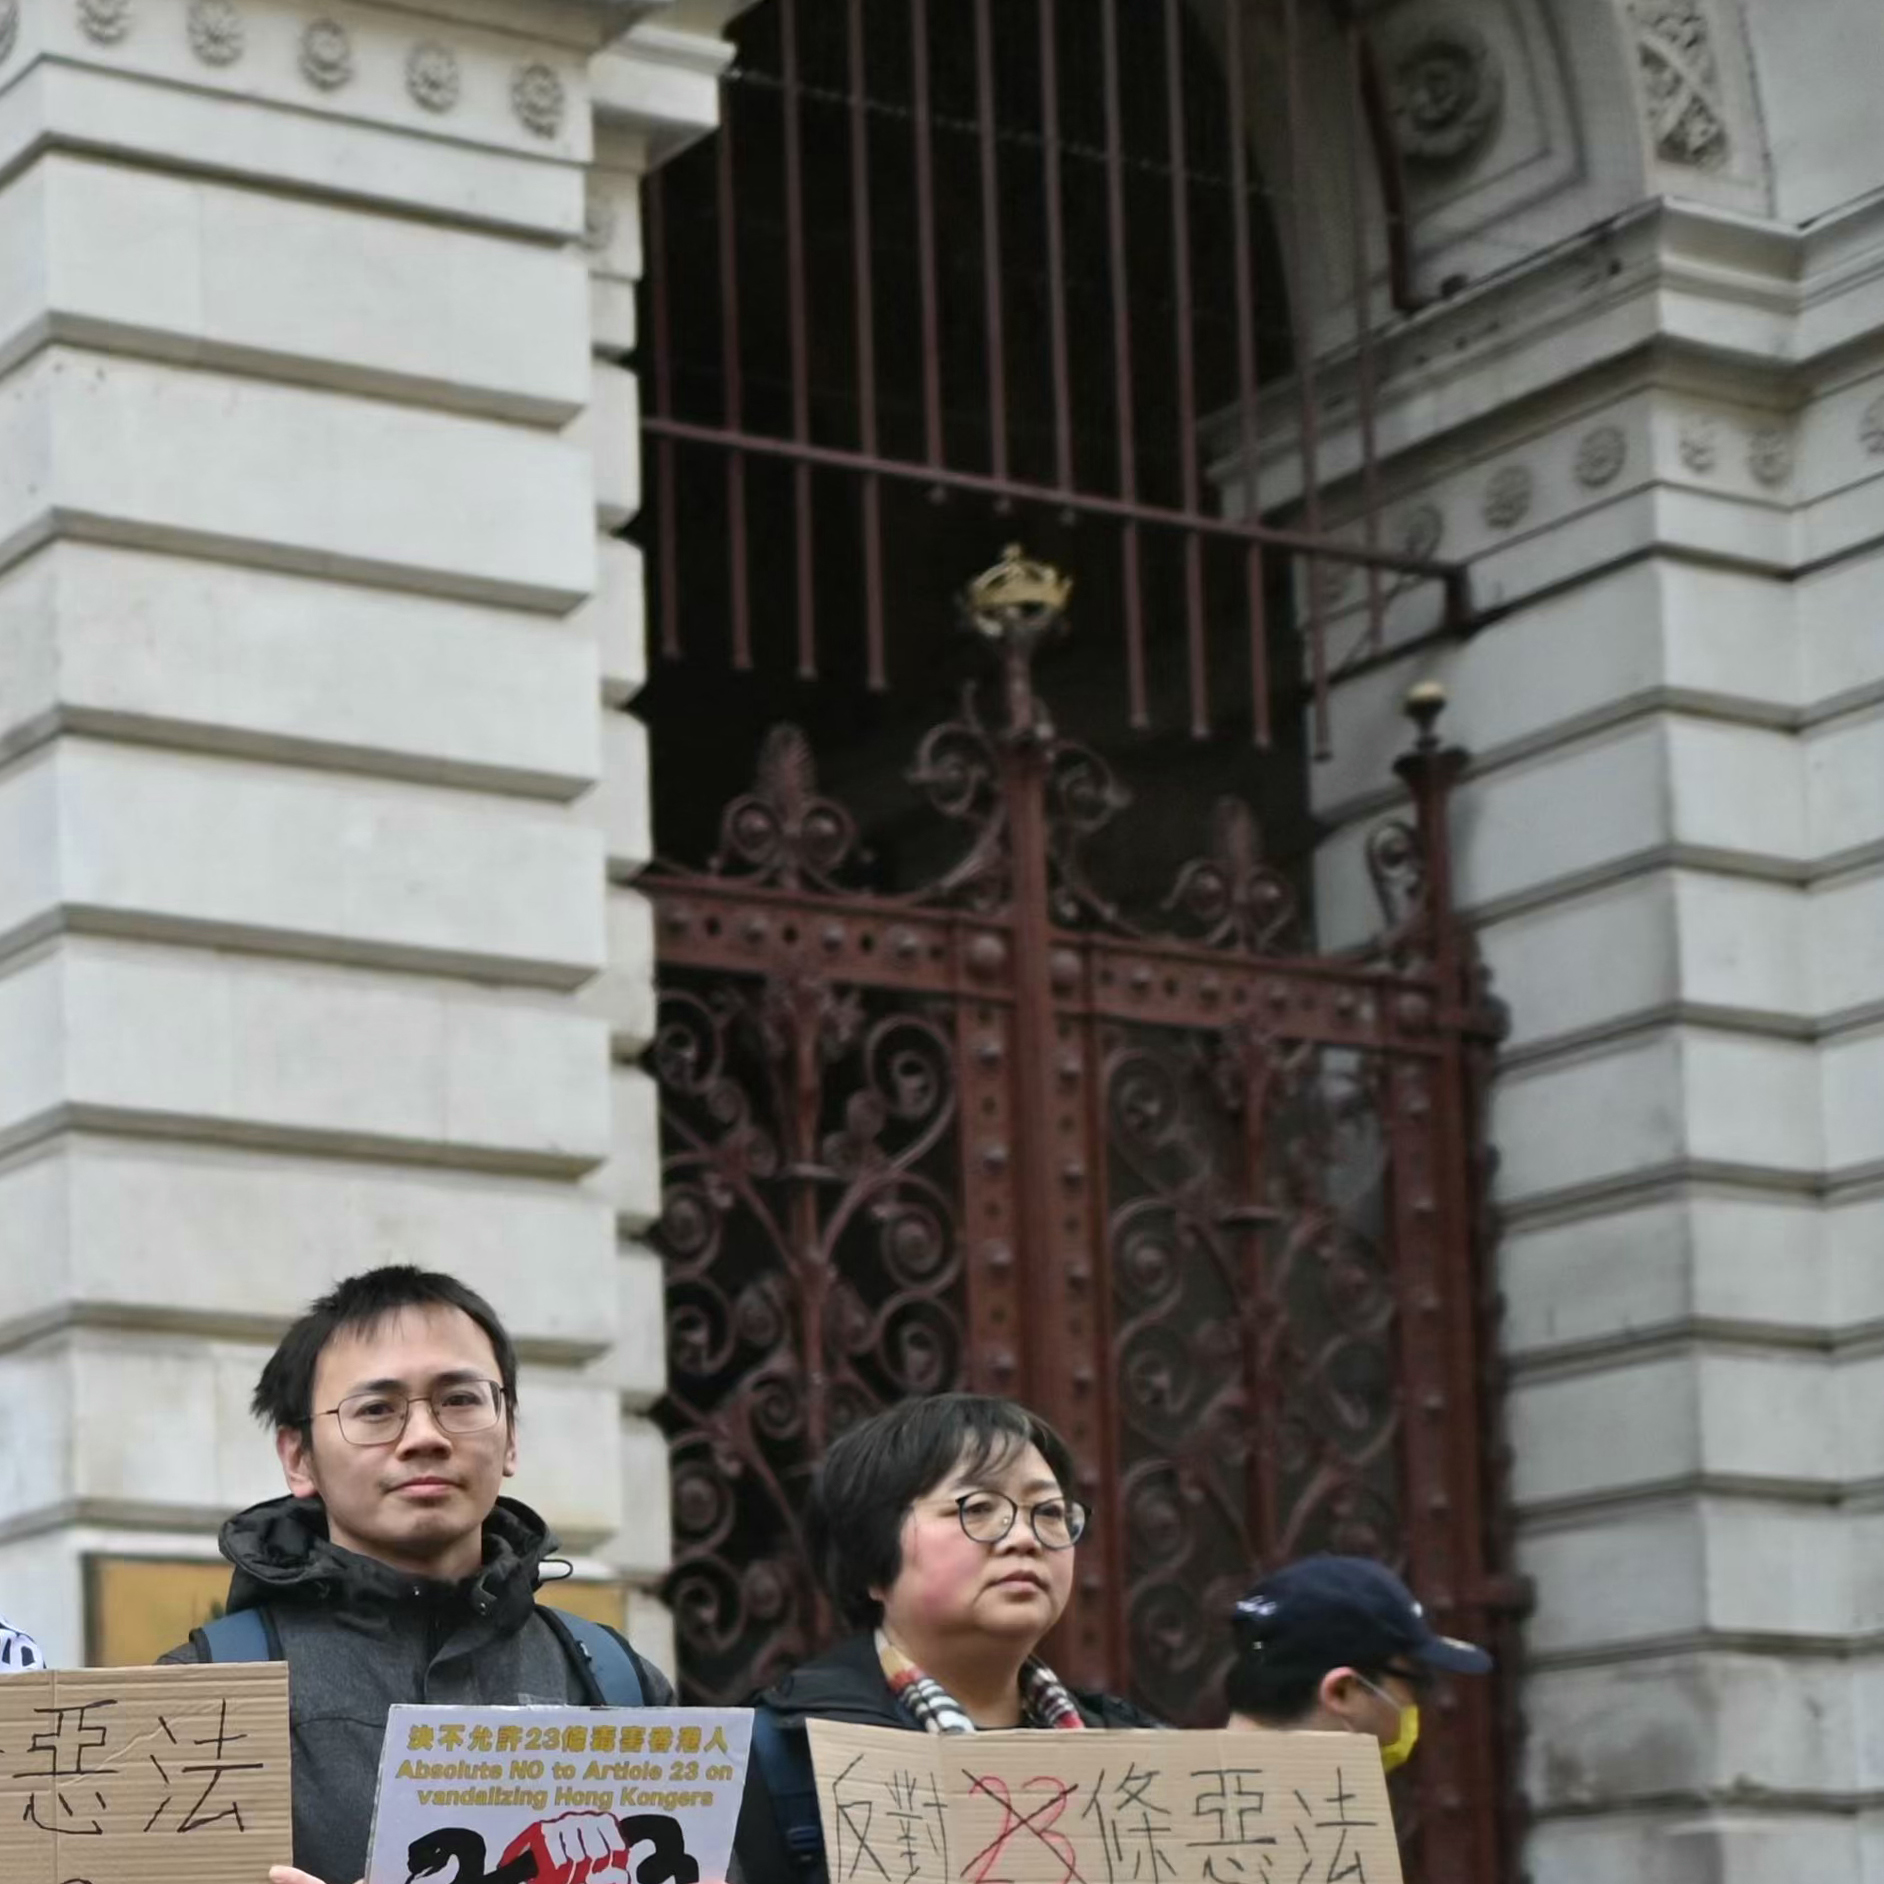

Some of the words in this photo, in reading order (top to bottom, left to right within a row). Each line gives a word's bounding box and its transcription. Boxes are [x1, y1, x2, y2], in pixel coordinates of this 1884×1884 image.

[395, 1759, 503, 1780] Absolute
[509, 1760, 545, 1780] NO
[552, 1762, 576, 1780] to
[582, 1760, 663, 1781] Article
[669, 1760, 700, 1781] 23
[705, 1764, 734, 1781] on
[554, 1786, 614, 1812] Hong
[620, 1786, 714, 1812] Kongers
